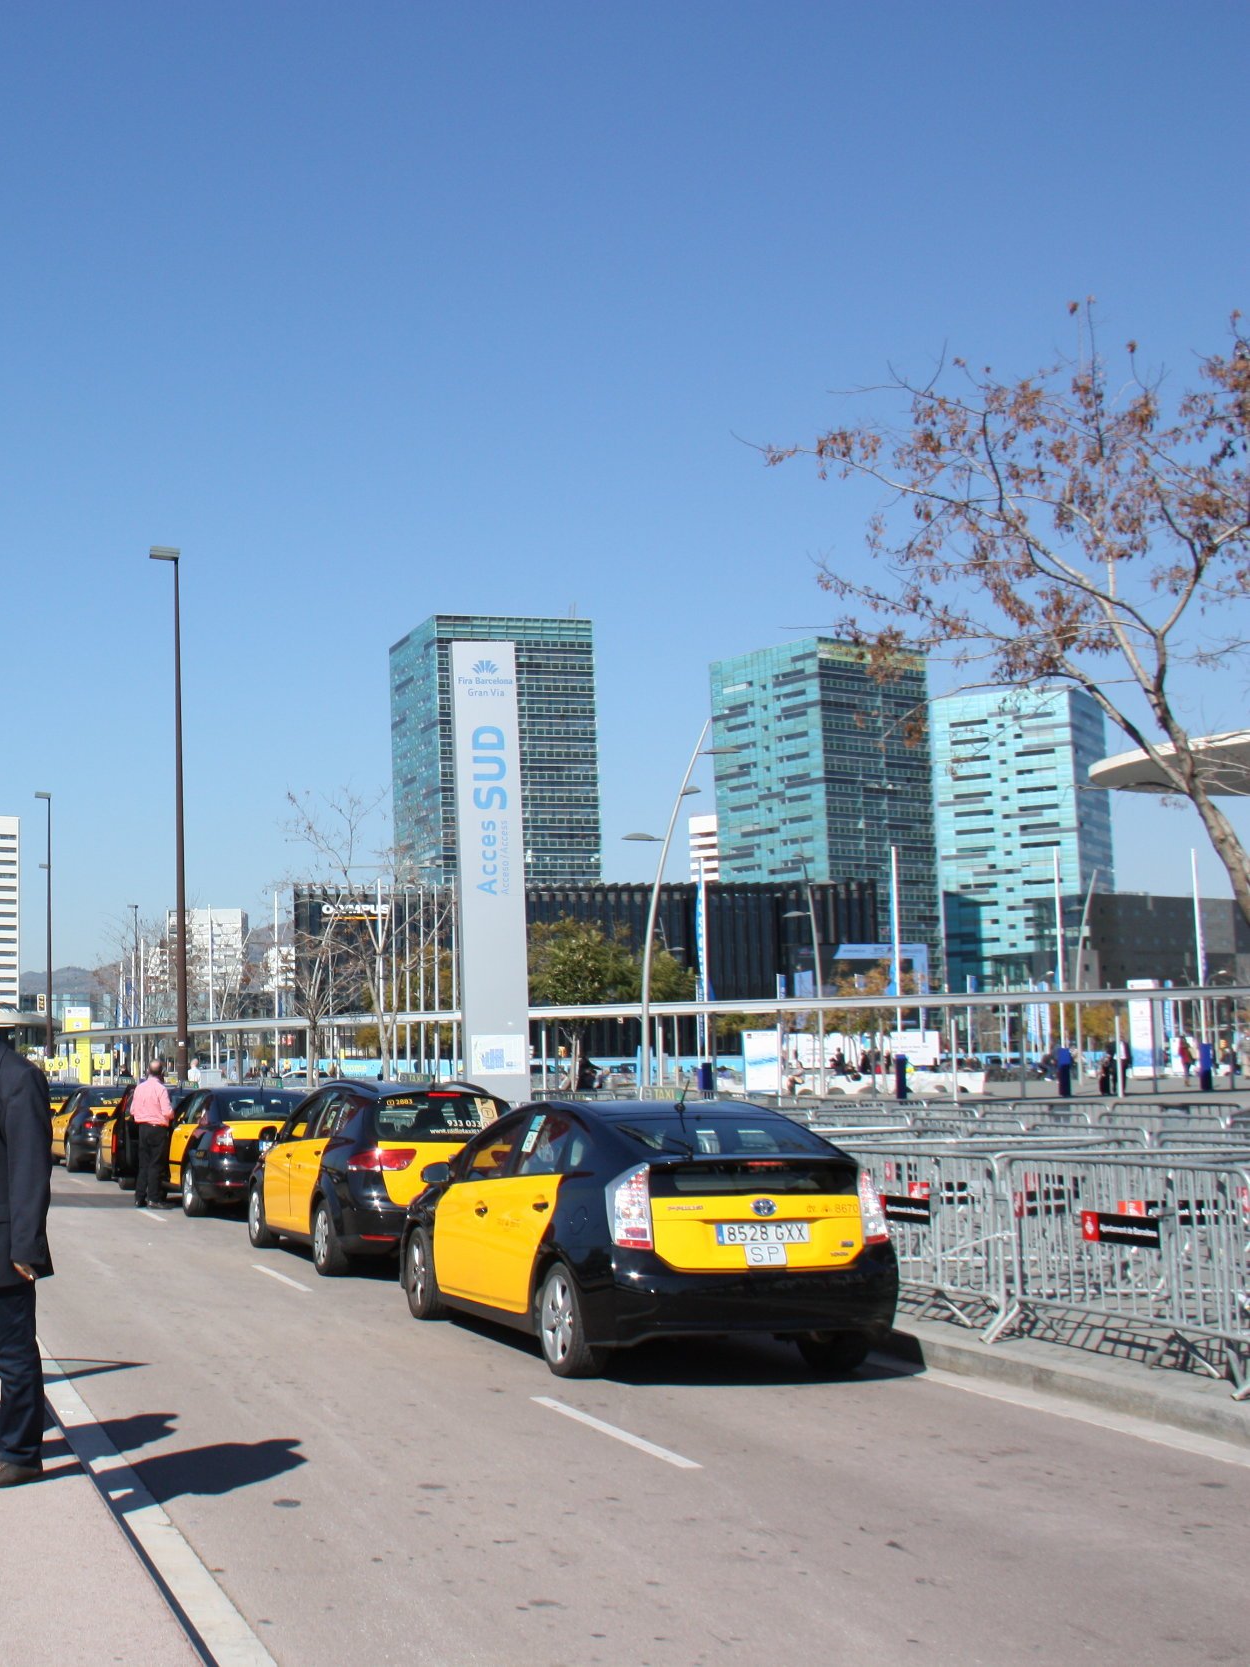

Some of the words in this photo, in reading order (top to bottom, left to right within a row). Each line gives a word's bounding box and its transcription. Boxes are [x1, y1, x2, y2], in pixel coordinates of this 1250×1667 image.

[457, 676, 473, 685] Fira
[475, 676, 513, 685] Barcelona
[467, 688, 489, 697] Gran
[490, 688, 505, 697] Via
[471, 725, 508, 810] SUD
[476, 819, 498, 896] Acces
[321, 903, 391, 915] OYMPUS
[407, 1074, 424, 1082] TAXI
[654, 1088, 675, 1099] TAXI
[446, 1119, 464, 1127] 933
[727, 1225, 769, 1242] 8528
[774, 1223, 806, 1241] GXX
[750, 1246, 780, 1263] SP
